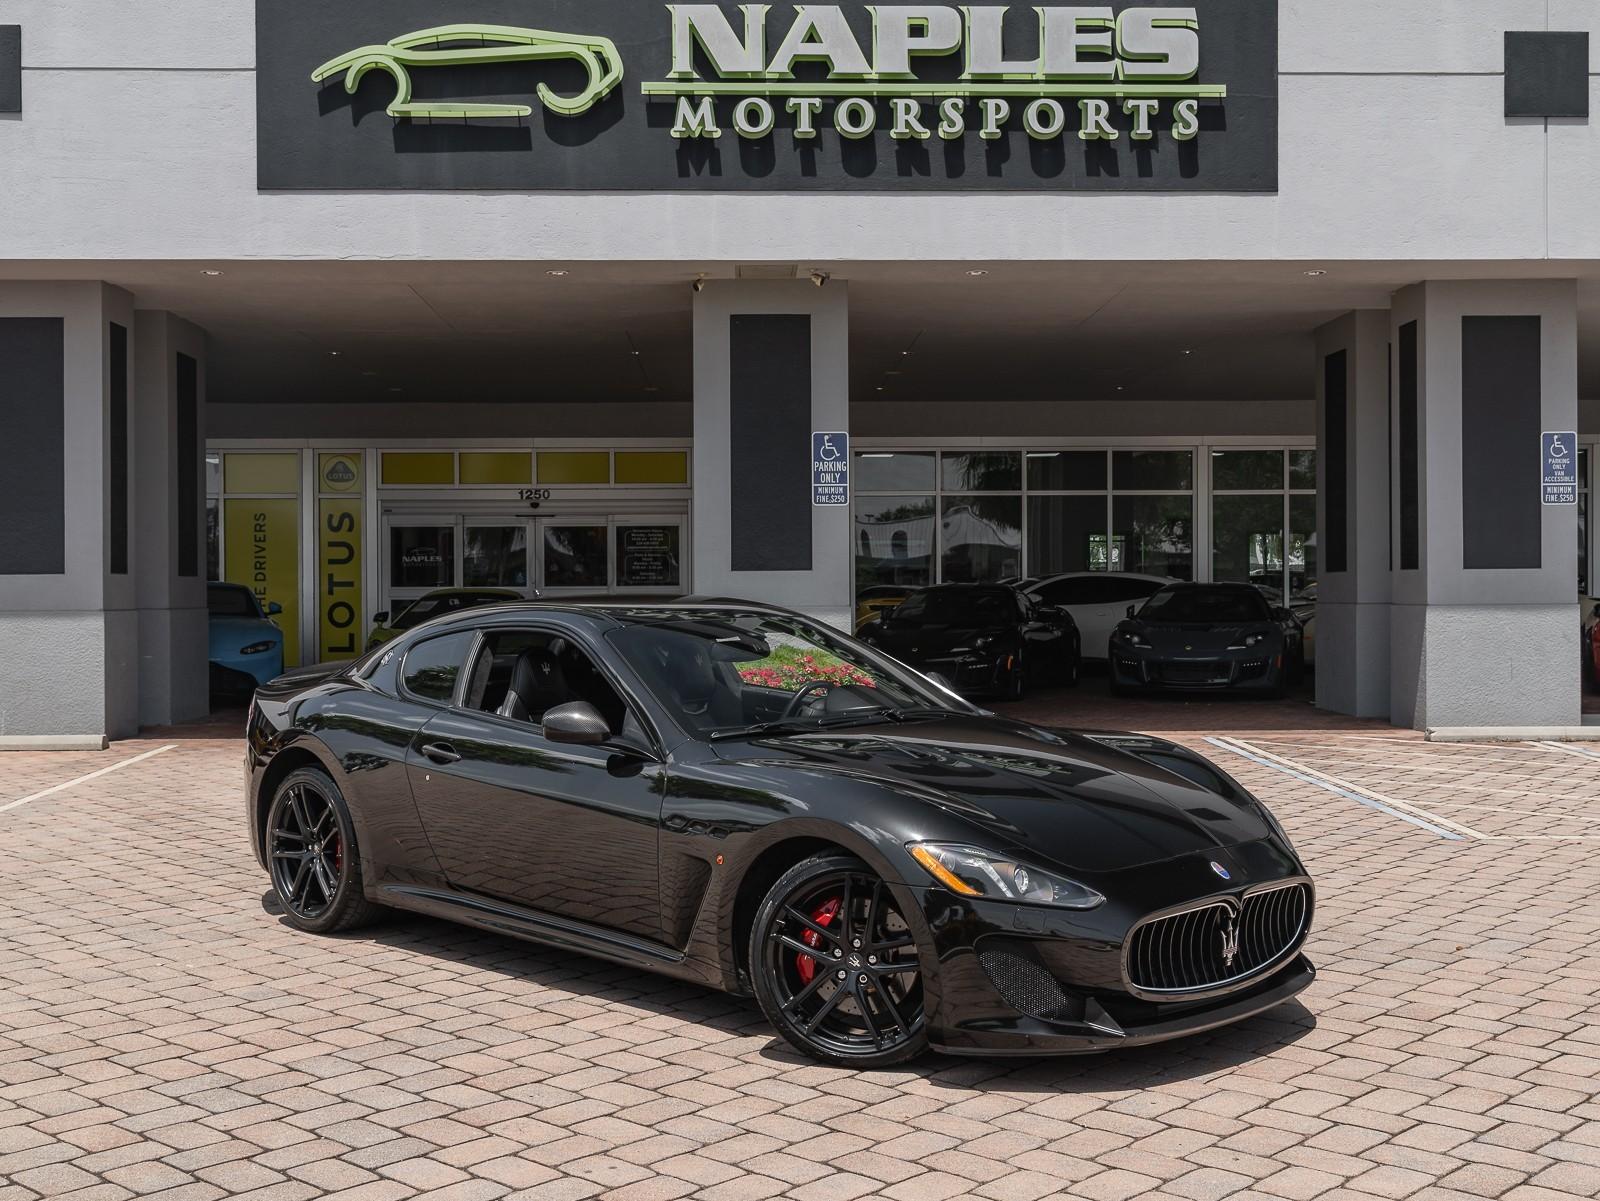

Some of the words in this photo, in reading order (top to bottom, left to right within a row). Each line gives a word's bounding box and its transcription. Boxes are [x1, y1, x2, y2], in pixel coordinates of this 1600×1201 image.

[665, 3, 1199, 81] NAPLES
[670, 96, 1200, 141] MOTORSPORTS
[814, 461, 847, 472] PARKING
[820, 473, 841, 483] ONLY
[518, 489, 550, 500] 1250
[1546, 486, 1572, 494] MINIMUM
[1560, 494, 1574, 503] $250
[254, 512, 267, 582] DRIVERS
[327, 512, 355, 653] LOTUS
